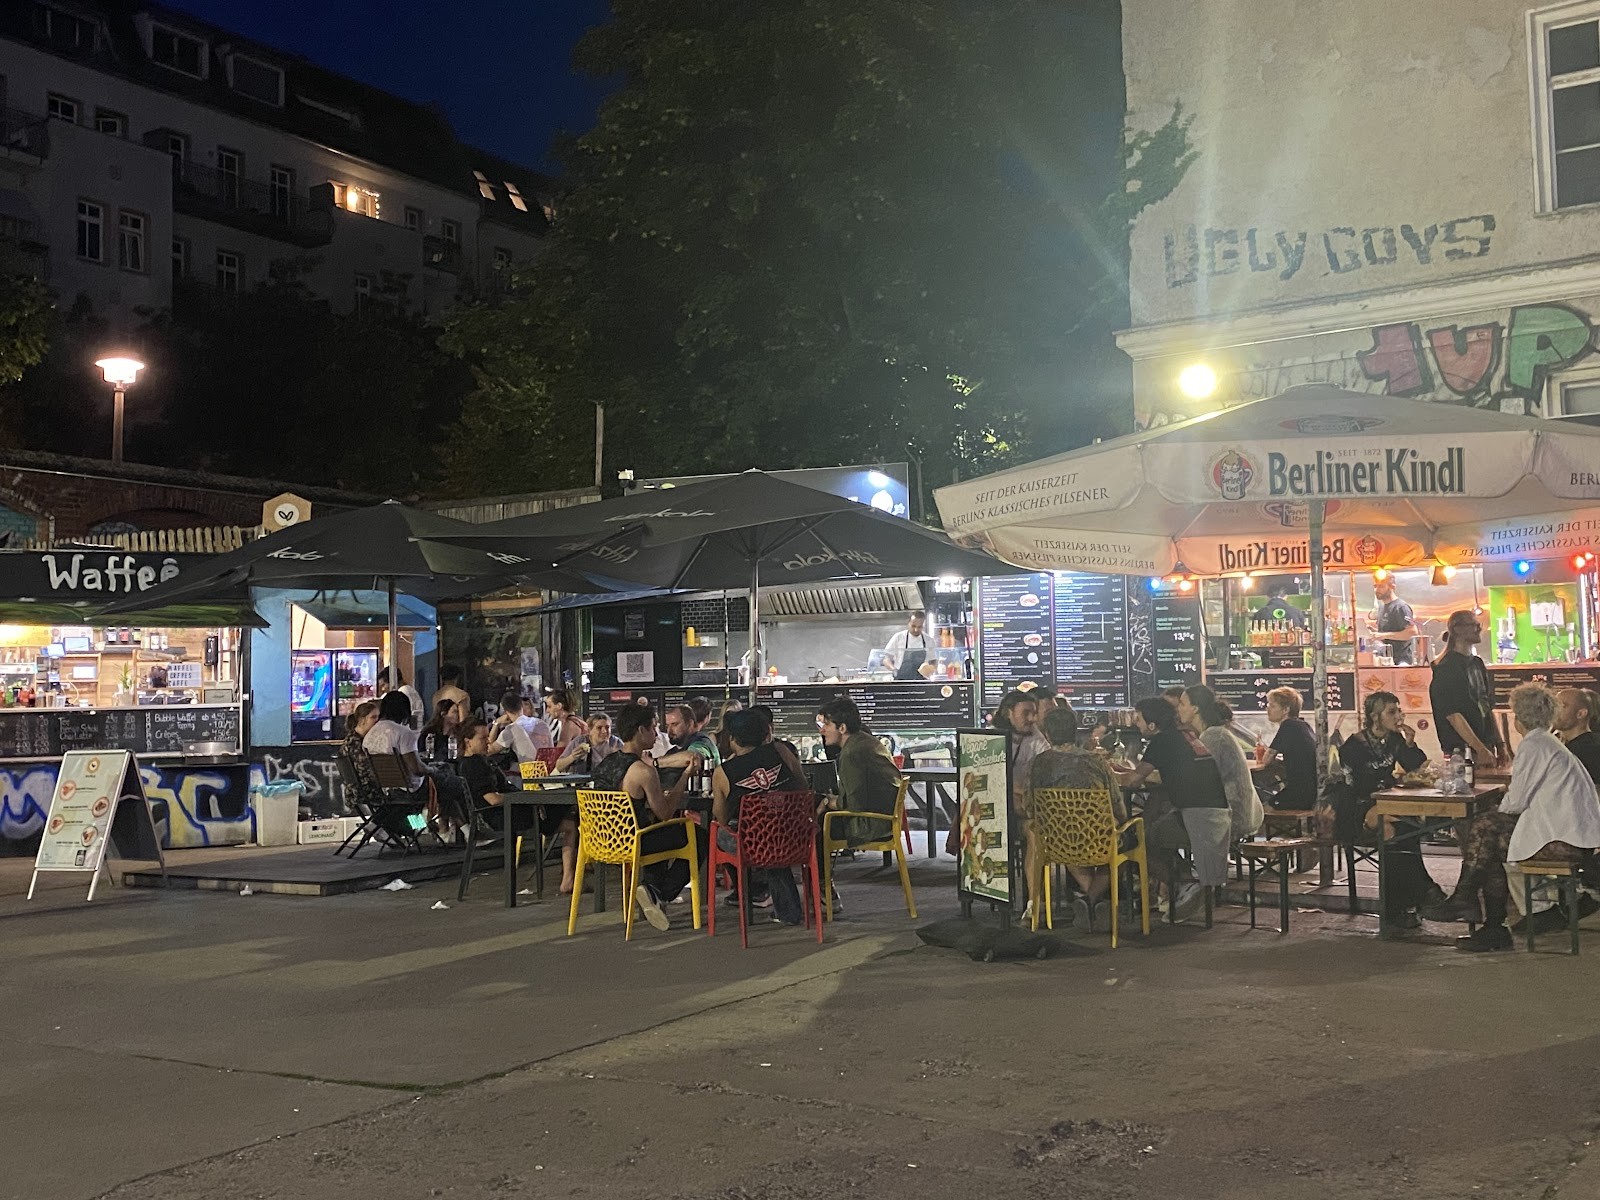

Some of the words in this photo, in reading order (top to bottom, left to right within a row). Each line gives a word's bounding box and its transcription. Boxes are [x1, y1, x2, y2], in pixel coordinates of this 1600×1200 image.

[975, 489, 996, 504] SEIT
[996, 486, 1016, 499] DER
[1018, 472, 1079, 494] KAISERZEIT
[1268, 450, 1383, 496] Berliner
[1385, 447, 1466, 494] Kindl
[952, 508, 985, 528] BERLINS
[987, 496, 1050, 518] KLASSISCHES
[1053, 487, 1110, 506] PILSENER
